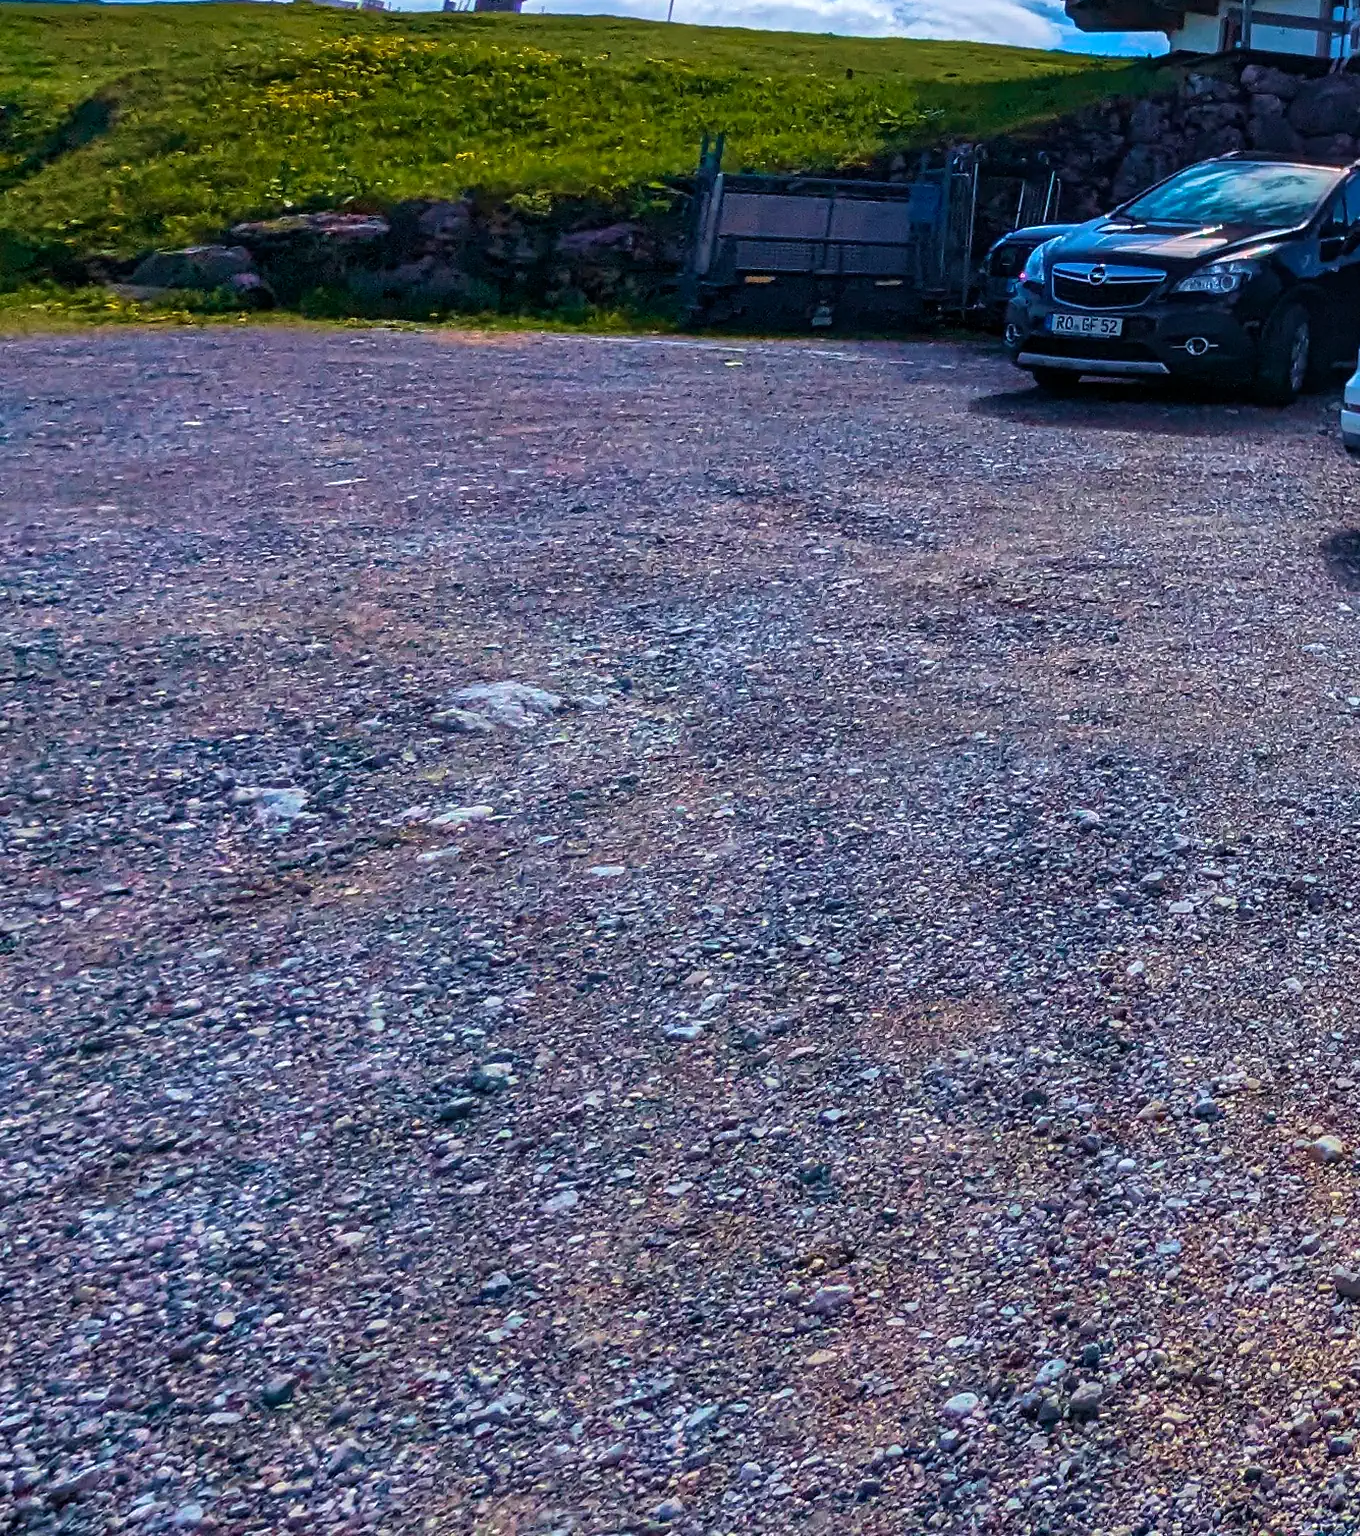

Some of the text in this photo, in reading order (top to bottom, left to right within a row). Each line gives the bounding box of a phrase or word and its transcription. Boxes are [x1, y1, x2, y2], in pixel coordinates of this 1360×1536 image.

[1056, 315, 1118, 334] RO GF 52
